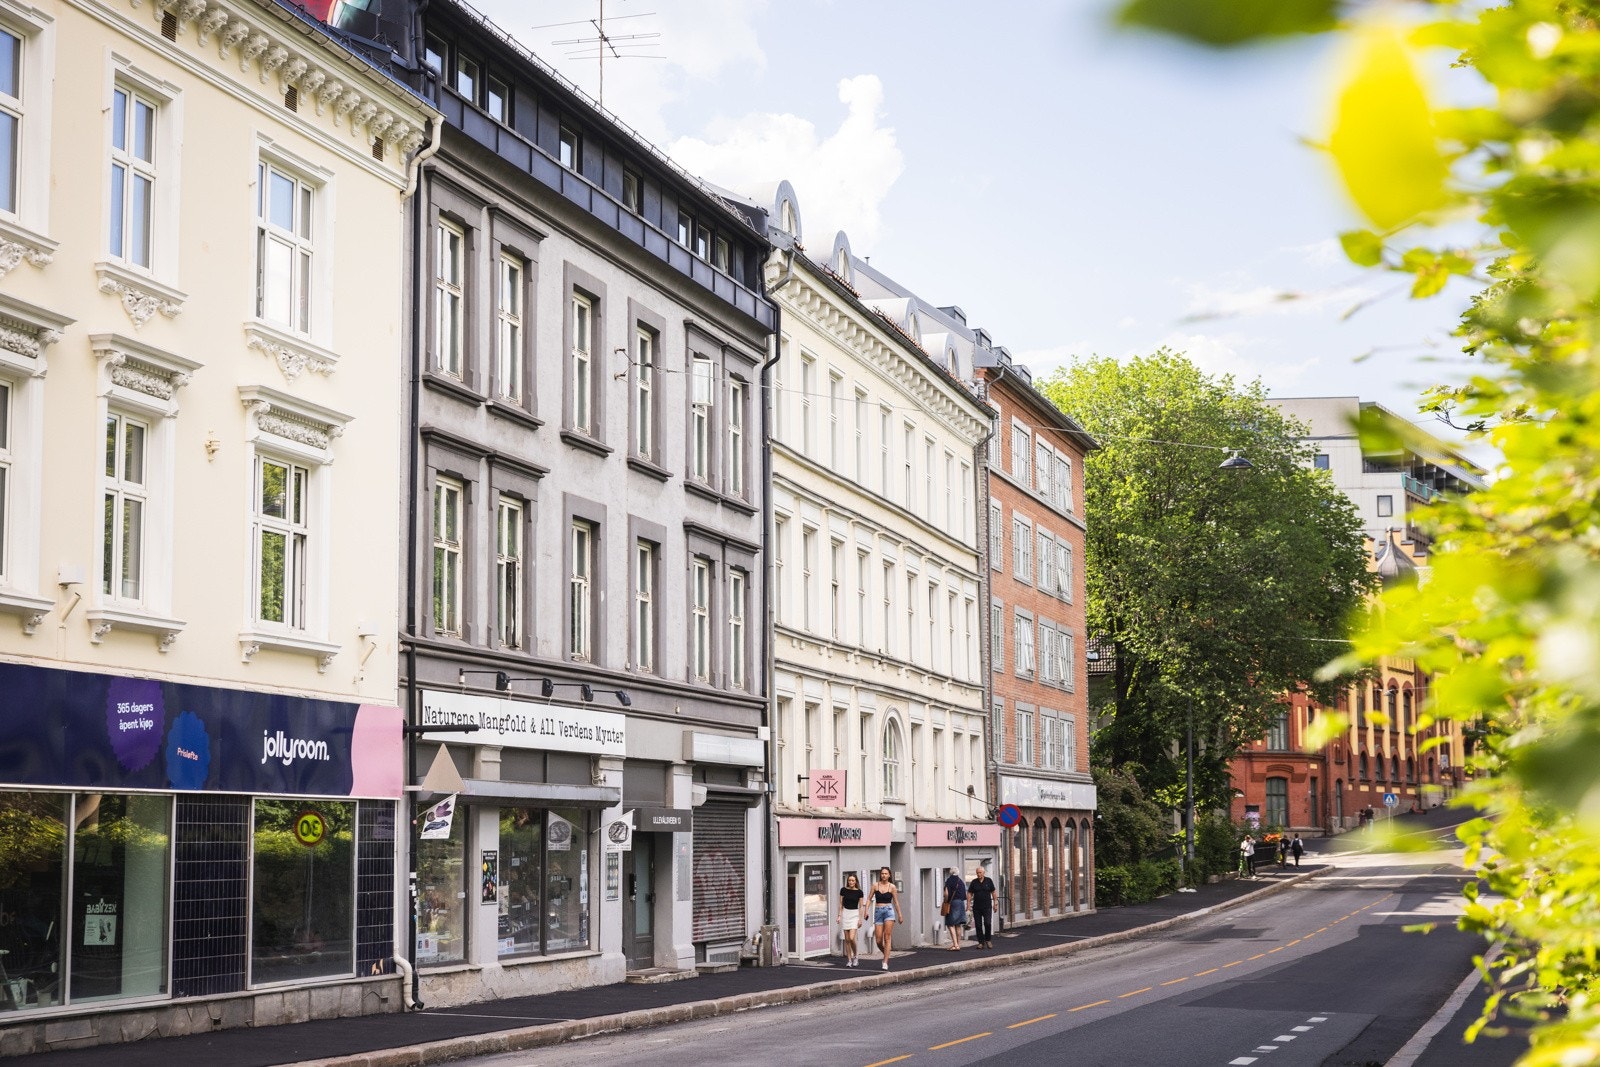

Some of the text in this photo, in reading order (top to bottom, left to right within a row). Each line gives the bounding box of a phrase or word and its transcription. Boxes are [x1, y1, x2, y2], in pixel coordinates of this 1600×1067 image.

[117, 702, 154, 714] 365 dagers
[118, 718, 154, 732] åpent kjøp
[424, 705, 625, 745] Naturens Mangfold & All Verdens Mynter
[261, 729, 330, 766] jollyroom.
